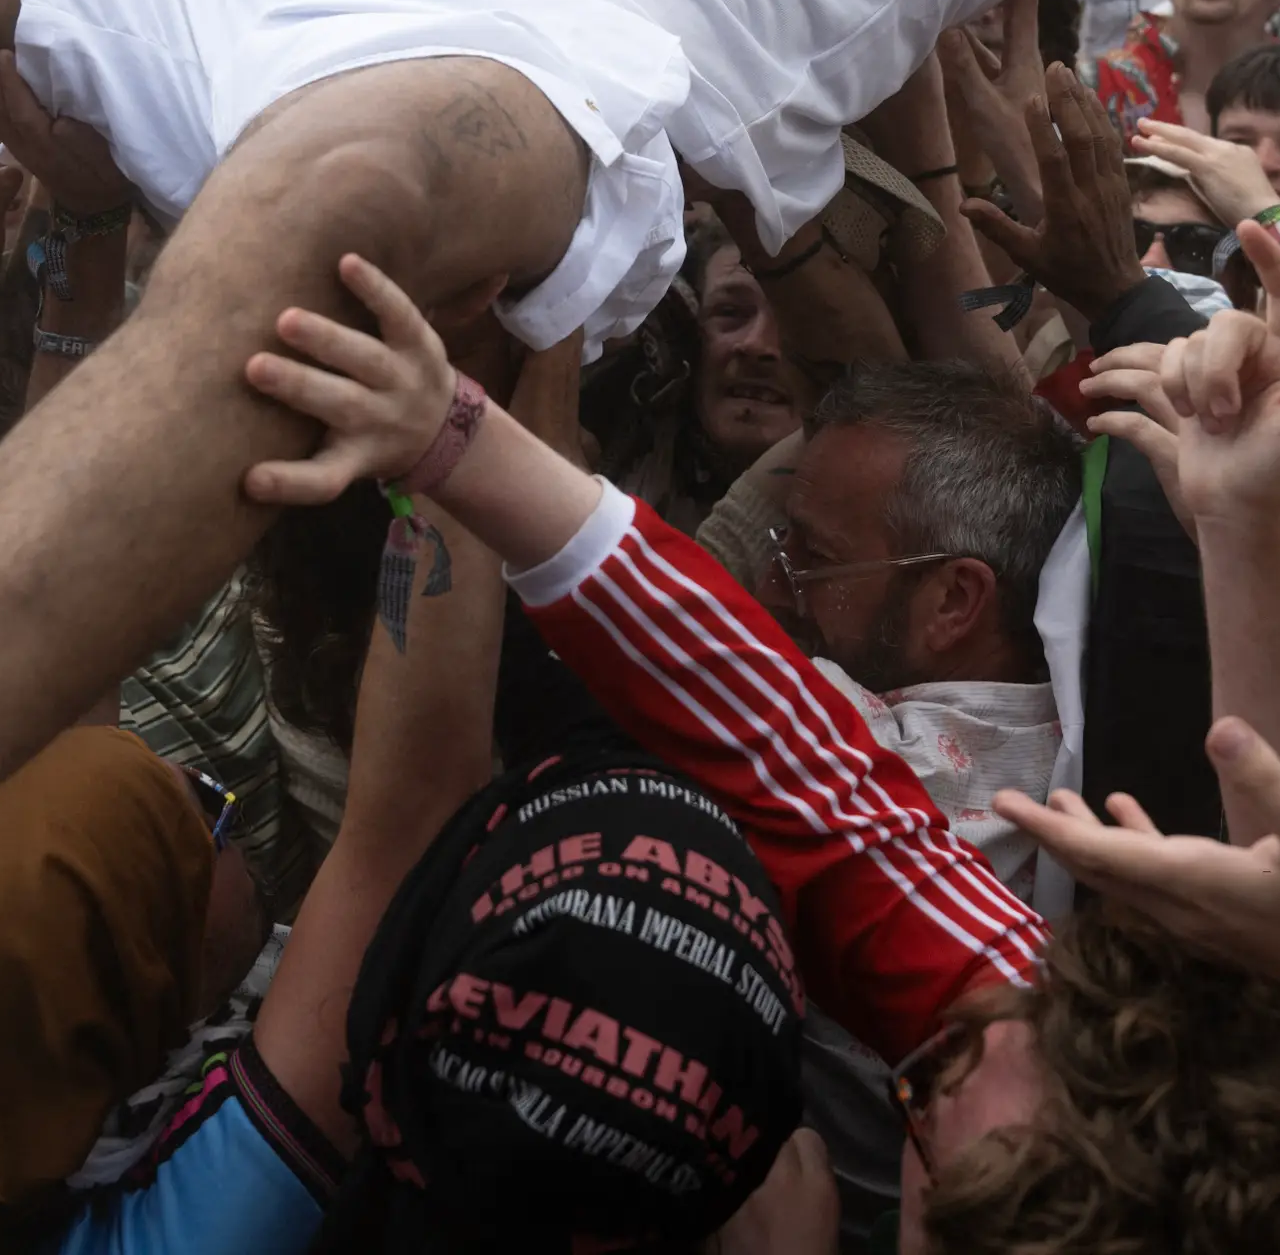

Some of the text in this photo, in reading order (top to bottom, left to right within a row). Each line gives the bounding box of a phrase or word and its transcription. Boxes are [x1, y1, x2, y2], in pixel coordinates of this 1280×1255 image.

[517, 777, 629, 824] RUSSIAN
[598, 861, 651, 883] ON
[660, 877, 793, 991] AMBURAN
[638, 905, 738, 986] IMPERIAL
[734, 962, 788, 1036] STOUT
[524, 1040, 678, 1123] BOURBON
